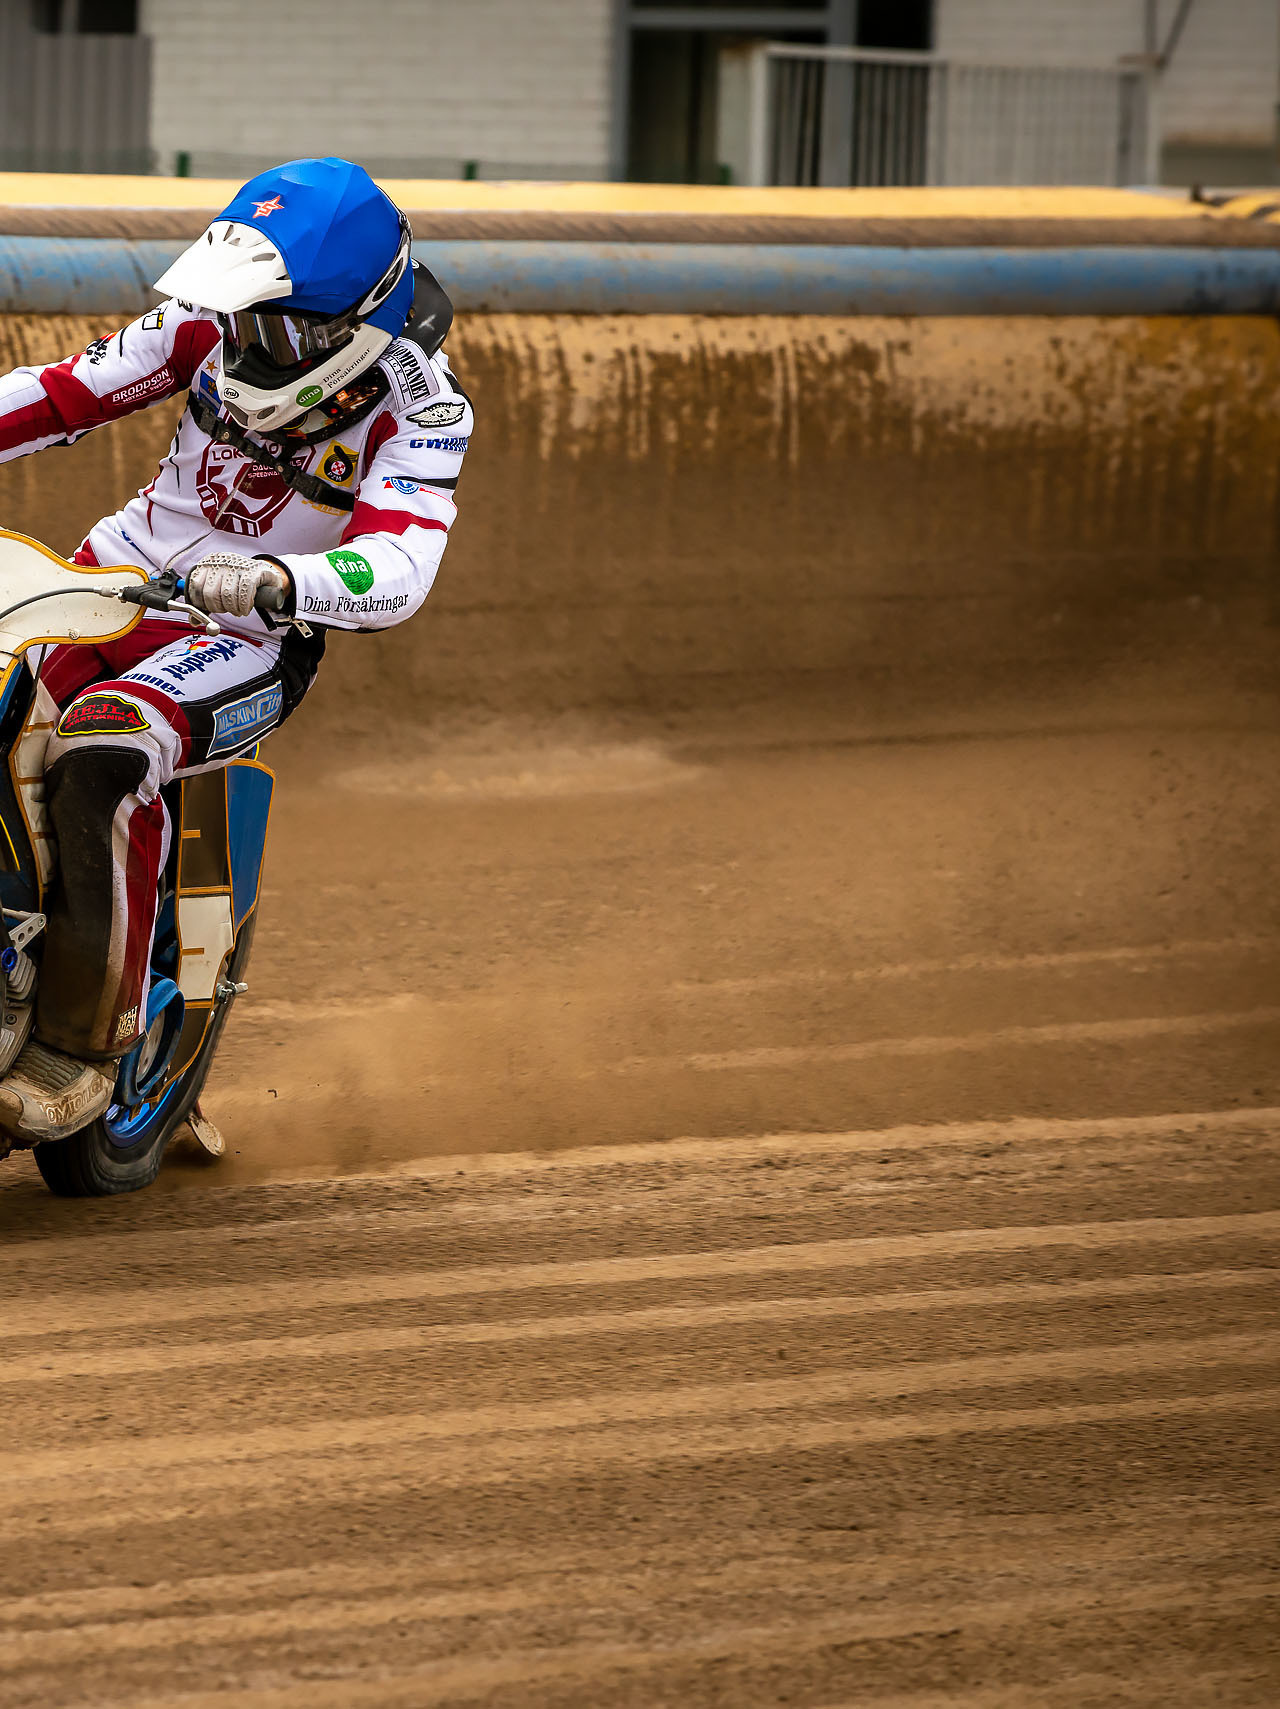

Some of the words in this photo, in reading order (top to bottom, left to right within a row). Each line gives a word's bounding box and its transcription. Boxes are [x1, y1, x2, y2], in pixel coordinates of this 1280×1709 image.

[112, 368, 170, 402] BRODDSON
[298, 387, 321, 404] dina
[335, 557, 369, 574] dina
[303, 595, 331, 613] Dina
[334, 593, 409, 614] Försäkringar
[65, 703, 140, 724] HEJLA
